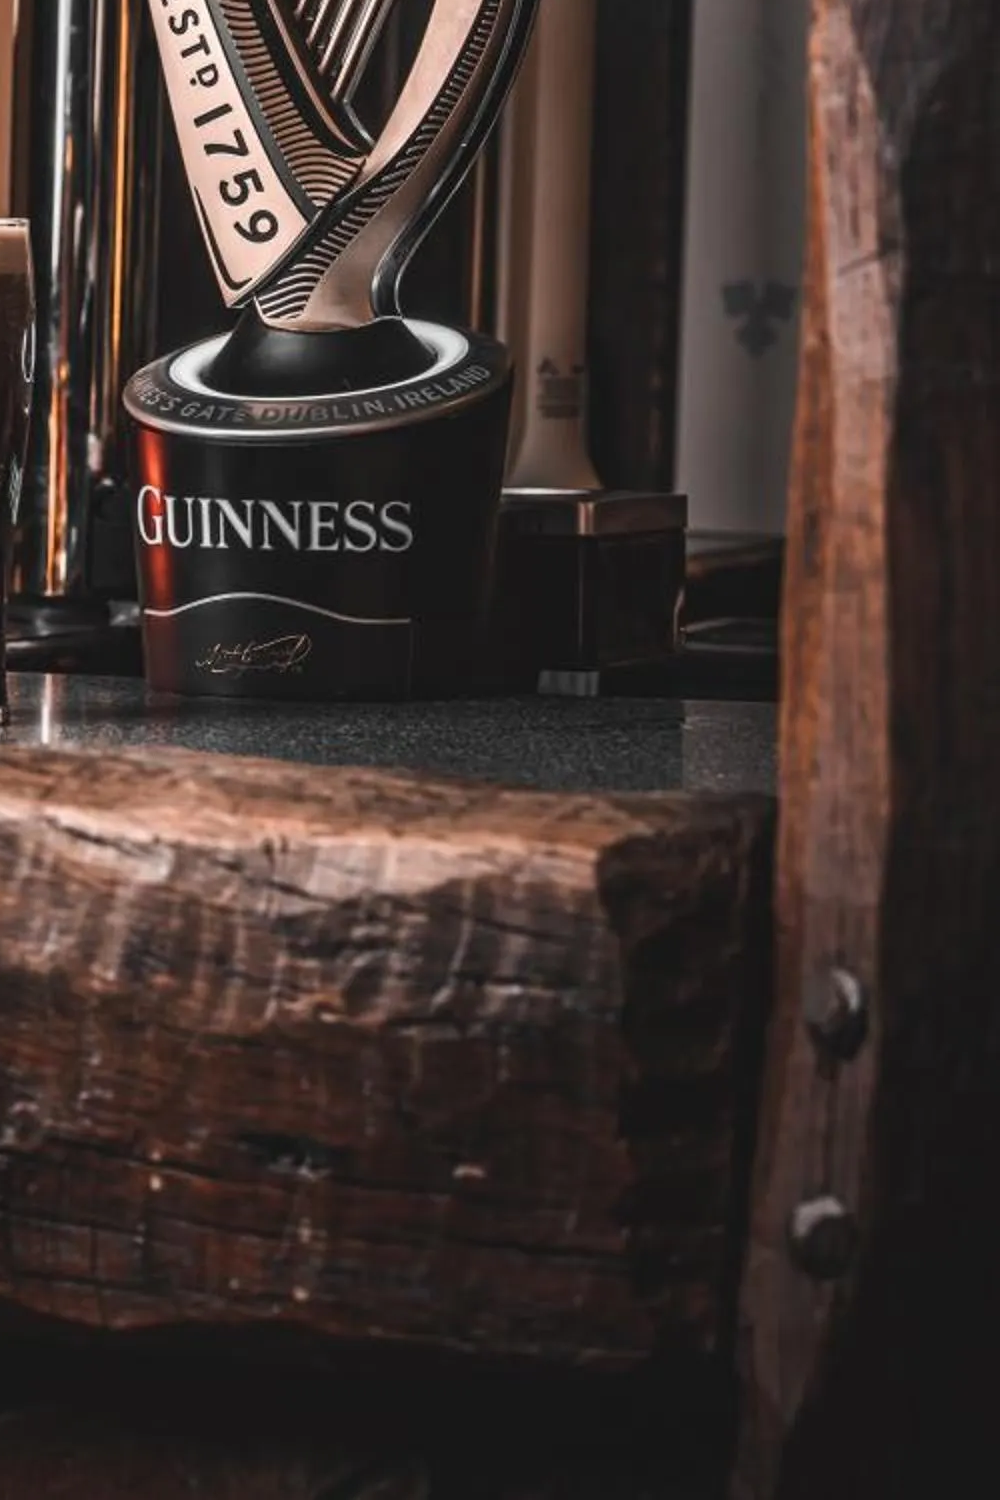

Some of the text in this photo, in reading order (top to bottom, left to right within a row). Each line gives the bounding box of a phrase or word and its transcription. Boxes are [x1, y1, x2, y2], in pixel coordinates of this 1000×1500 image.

[193, 103, 279, 244] 1759
[180, 401, 249, 422] GATE
[394, 364, 492, 410] IRELAND
[137, 484, 415, 552] GUINNESS
